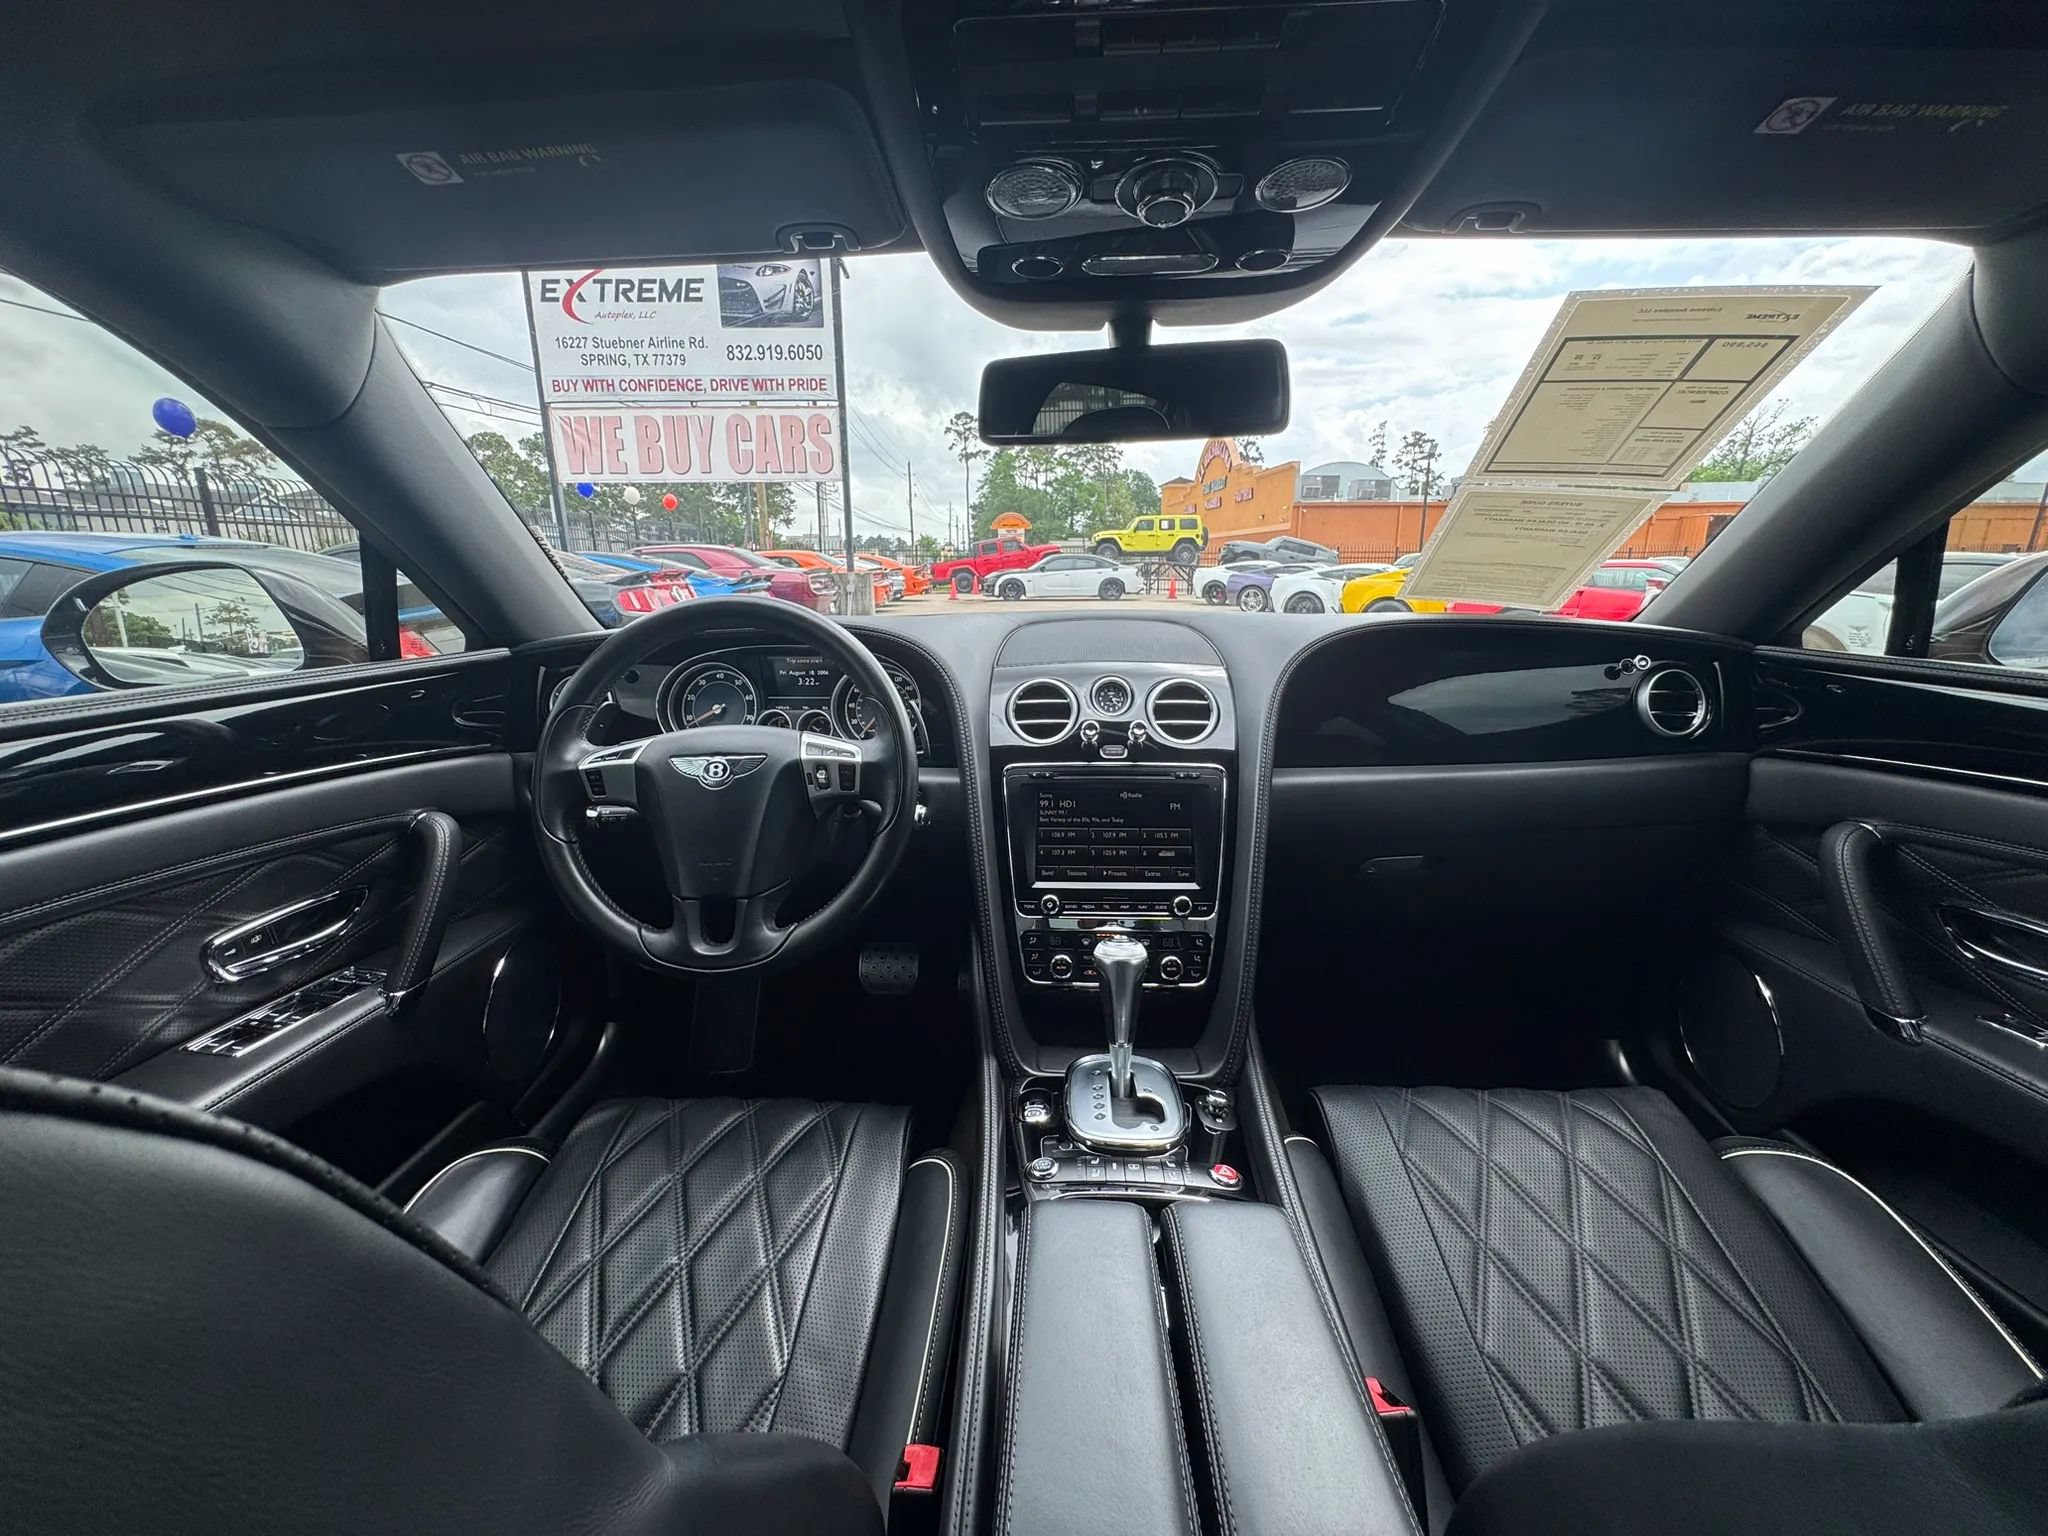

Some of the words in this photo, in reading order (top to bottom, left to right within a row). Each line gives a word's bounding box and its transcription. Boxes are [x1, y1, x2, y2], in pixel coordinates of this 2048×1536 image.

[540, 270, 705, 312] EXTREME
[555, 337, 588, 349] 16227
[592, 337, 645, 349] Stuebner
[648, 337, 686, 349] Airline
[689, 337, 709, 349] Rd.
[726, 344, 823, 361] 832.919.6050
[580, 354, 630, 368] SPRING,
[633, 354, 650, 366] TX
[652, 354, 686, 366] 77379
[552, 379, 578, 393] BUY
[582, 379, 615, 392] WITH
[619, 379, 707, 394] CONFIDENCE,
[710, 378, 749, 392] DRIVE
[752, 378, 785, 391] WITH
[789, 378, 827, 391] PRIDE
[561, 414, 628, 475] WE
[634, 414, 715, 475] BUY
[725, 413, 834, 475] CARS
